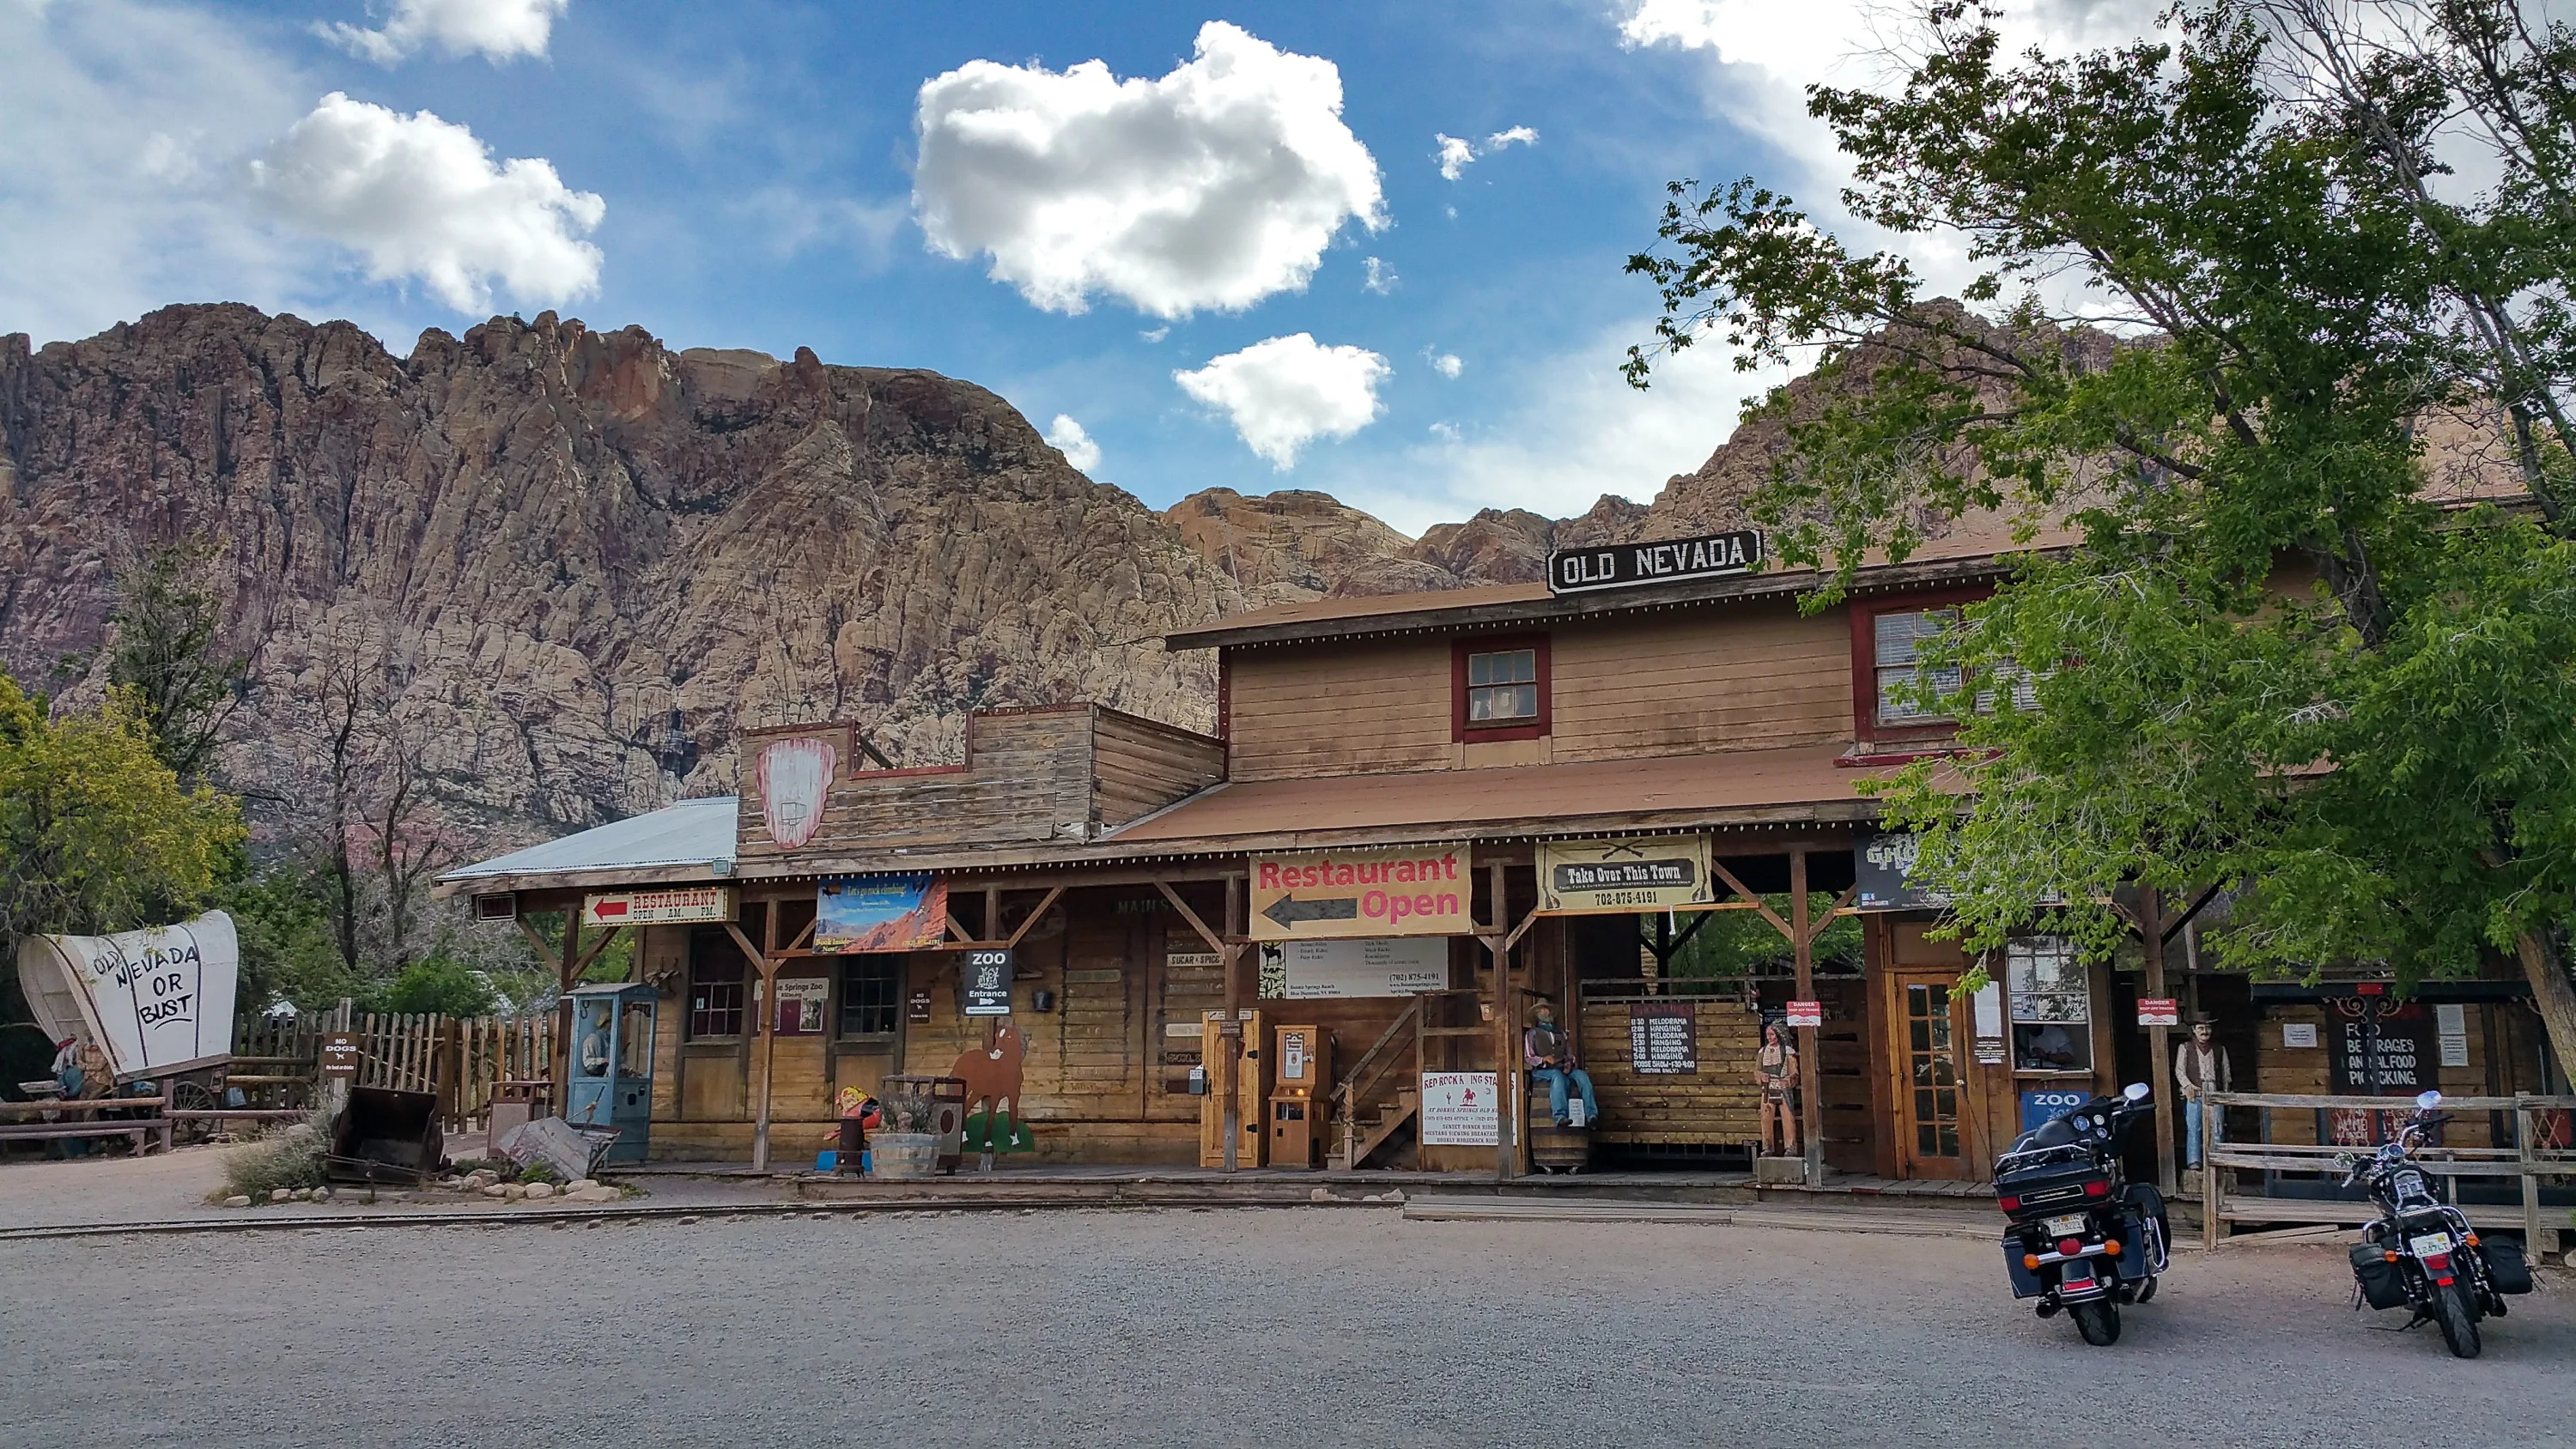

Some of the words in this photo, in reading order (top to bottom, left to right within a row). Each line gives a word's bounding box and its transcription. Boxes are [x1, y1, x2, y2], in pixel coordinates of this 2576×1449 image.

[1563, 553, 1615, 584] OLD
[1635, 537, 1747, 576] NEVADA
[1259, 852, 1458, 890] Restaurant
[1568, 868, 1595, 884] Take
[1597, 867, 1621, 882] Over
[1623, 865, 1649, 881] This
[1650, 864, 1681, 879] Town
[633, 892, 718, 909] RESTAURANT
[1117, 898, 1157, 914] MAIN
[1595, 891, 1657, 906] 702-875-4191
[633, 910, 654, 919] OPEN
[667, 908, 684, 918] AM.
[701, 906, 717, 916] PM.
[1362, 889, 1459, 925] Open
[816, 937, 832, 946] Book
[93, 950, 120, 974] OLD
[115, 945, 200, 988] NEVADA
[972, 953, 1006, 965] ZOO
[1389, 973, 1407, 982] (702)
[1408, 972, 1440, 981] 875-4191
[152, 973, 183, 997] OR
[785, 983, 809, 992] Springs
[139, 993, 193, 1024] BUST
[2347, 1039, 2415, 1053] BERAGES
[2348, 1056, 2389, 1070] ANAL
[1438, 1075, 1459, 1087] ROCK
[2034, 1094, 2081, 1106] ZOO
